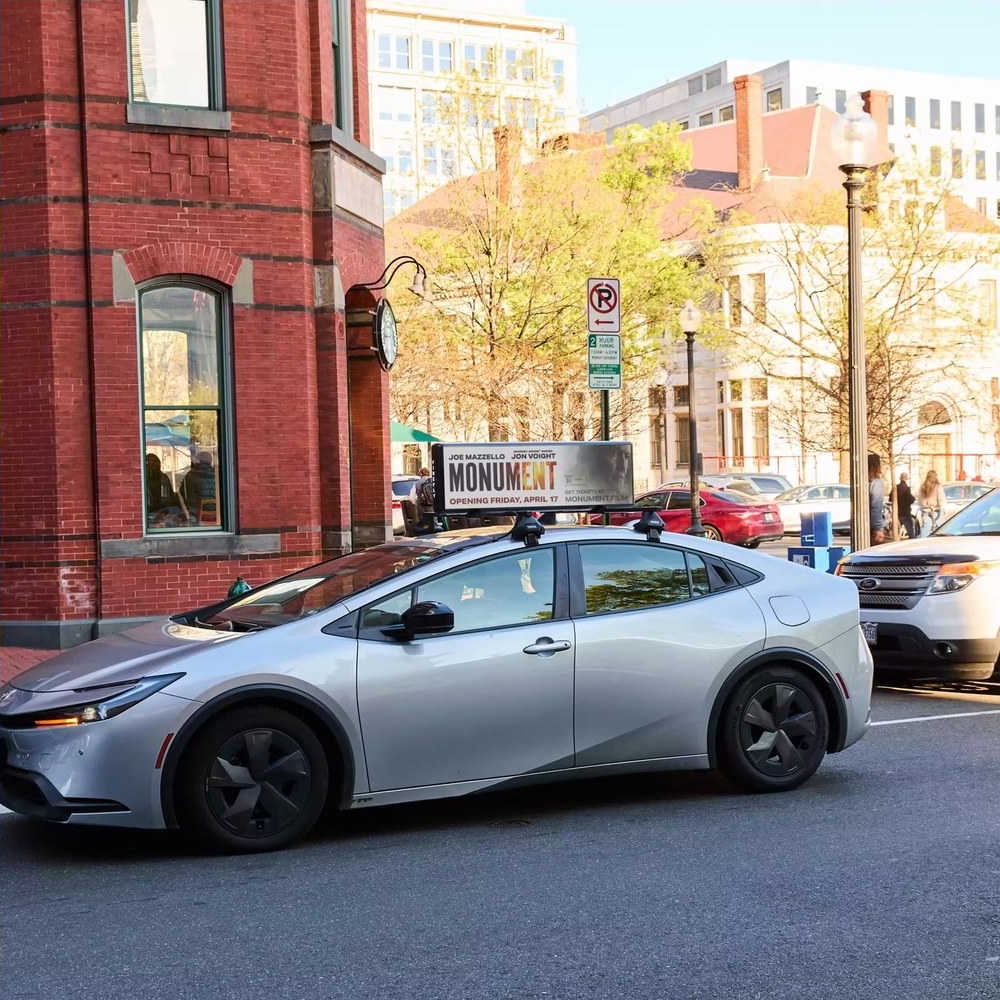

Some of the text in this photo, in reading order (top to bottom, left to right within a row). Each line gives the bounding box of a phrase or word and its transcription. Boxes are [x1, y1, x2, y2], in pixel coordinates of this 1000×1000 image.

[590, 337, 596, 346] 2
[449, 461, 557, 492] MONUMENT
[565, 495, 628, 503] MONUMENT.FILM
